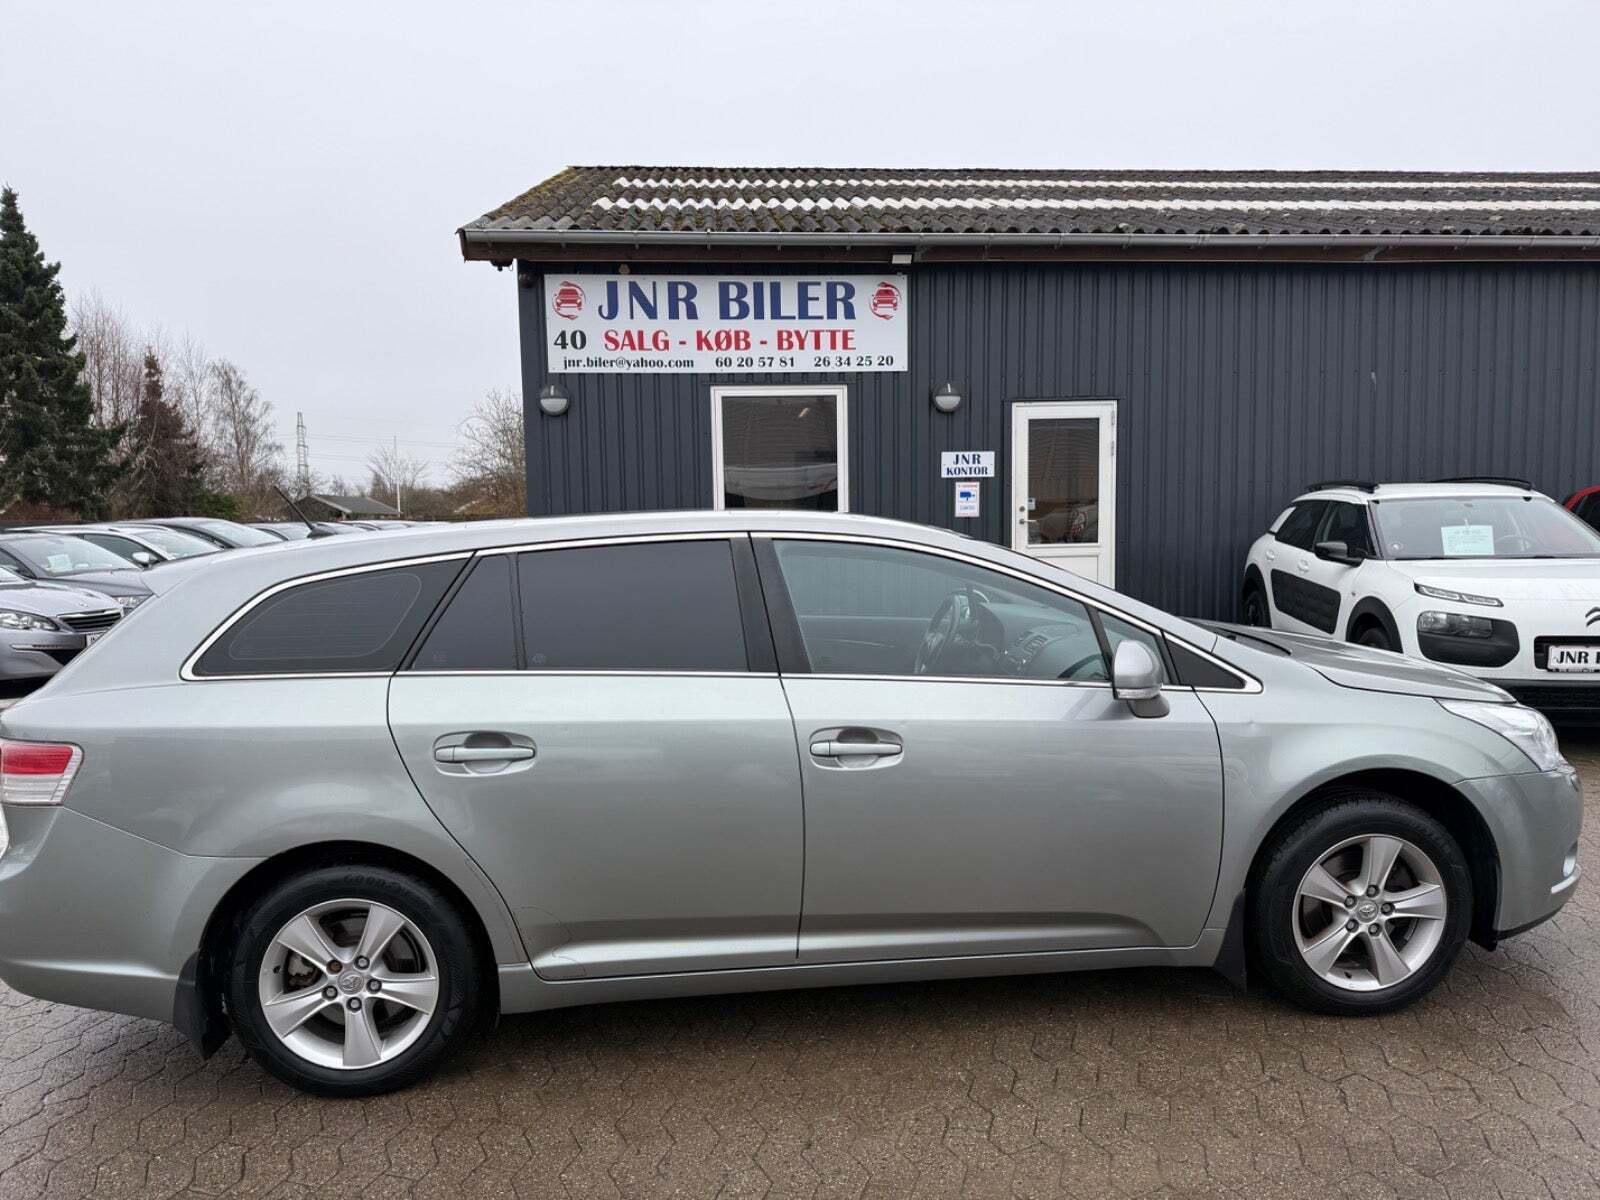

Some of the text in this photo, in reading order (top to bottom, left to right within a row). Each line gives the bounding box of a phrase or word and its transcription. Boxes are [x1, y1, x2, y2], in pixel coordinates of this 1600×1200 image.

[598, 280, 856, 320] JNR BILER
[554, 330, 586, 350] 40
[604, 330, 669, 351] SALG
[696, 329, 751, 352] KØB
[777, 330, 856, 351] BYTTE
[564, 357, 694, 370] jnr.biler@yahoo.com
[716, 357, 794, 367] 60 20 57 81
[814, 355, 894, 367] 26 34 25 20
[953, 454, 981, 465] JNR
[946, 466, 988, 476] KONTOR
[1554, 651, 1589, 664] JNR
